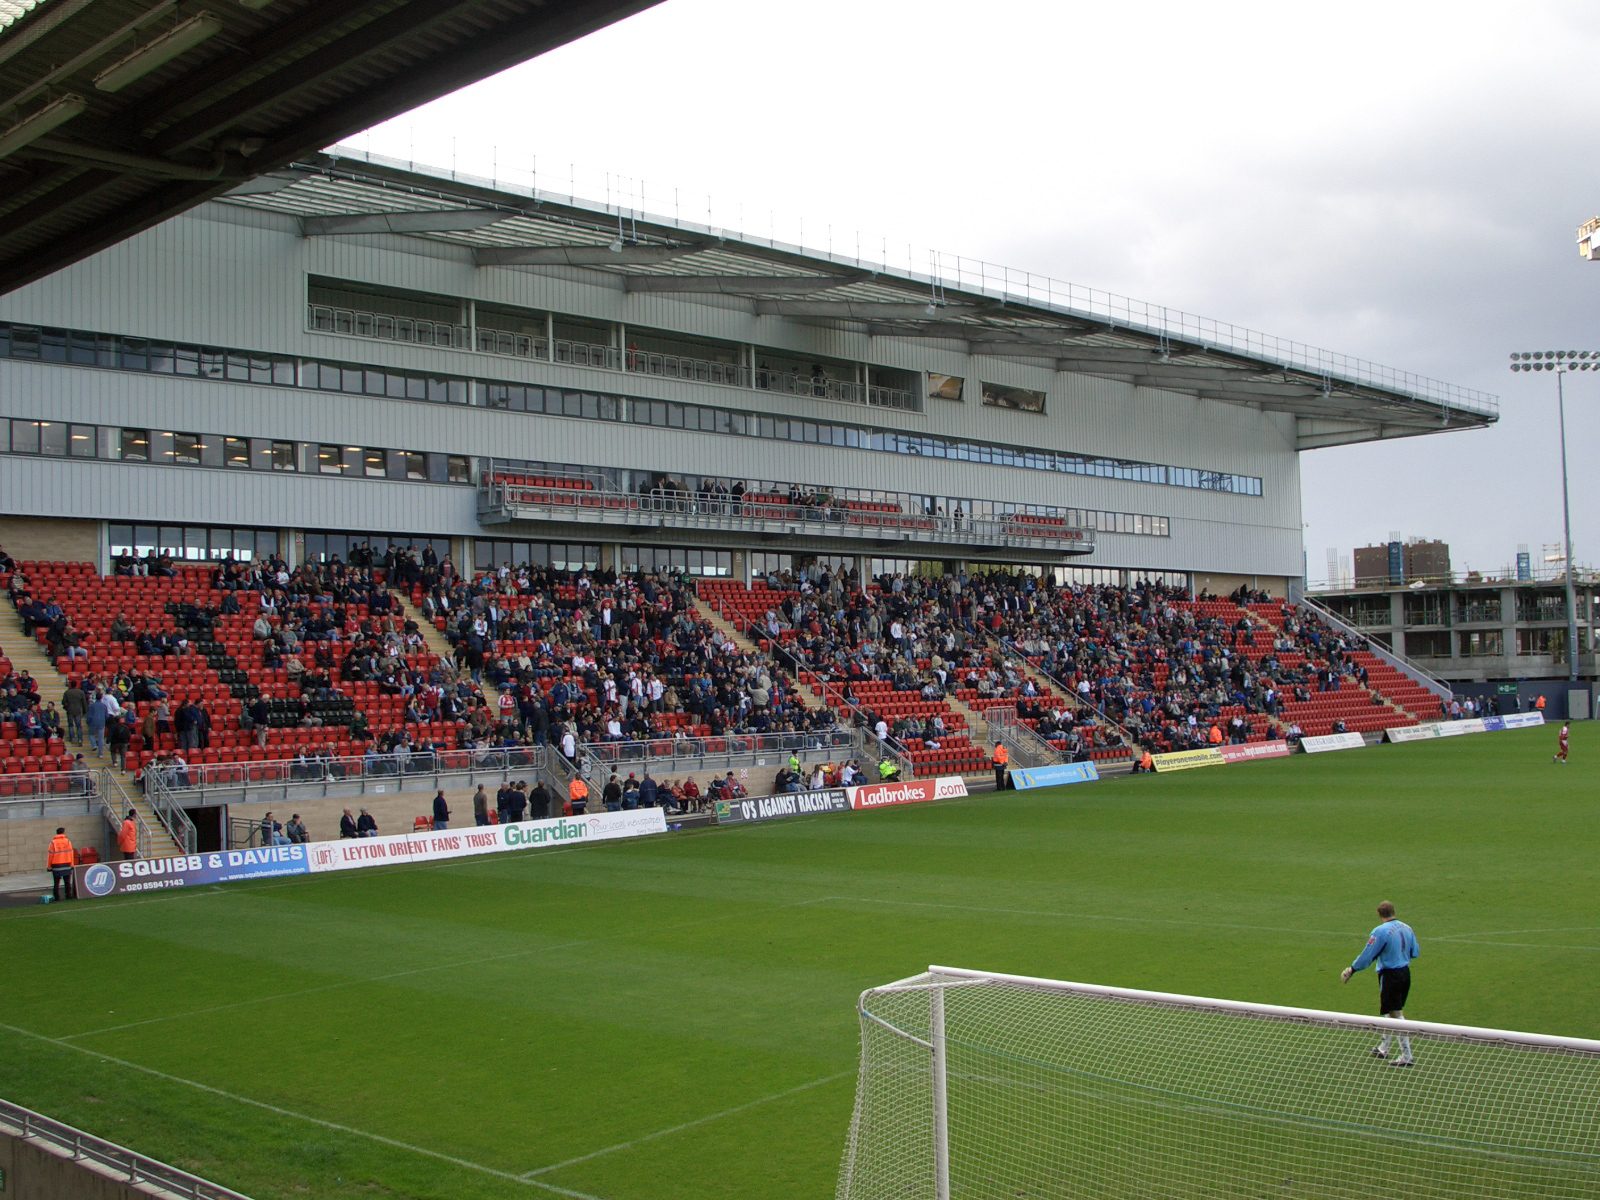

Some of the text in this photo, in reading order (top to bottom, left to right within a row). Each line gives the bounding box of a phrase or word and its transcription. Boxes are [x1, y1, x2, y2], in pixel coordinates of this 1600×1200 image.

[741, 800, 758, 820] O'S
[758, 795, 798, 818] AGAINST
[797, 792, 833, 813] RACISM
[860, 785, 925, 806] Ladbrokes
[504, 819, 588, 846] Guardian
[316, 849, 333, 865] LOFT
[342, 844, 387, 861] LEYTON
[389, 839, 428, 857] ORIENT
[431, 836, 462, 852] FANS'
[464, 832, 498, 848] TRUST
[119, 855, 203, 878] SQUIBB
[208, 854, 223, 869] &
[228, 846, 304, 867] DAVIES
[126, 883, 141, 892] 020
[143, 881, 163, 890] 8594
[164, 878, 184, 887] 7143
